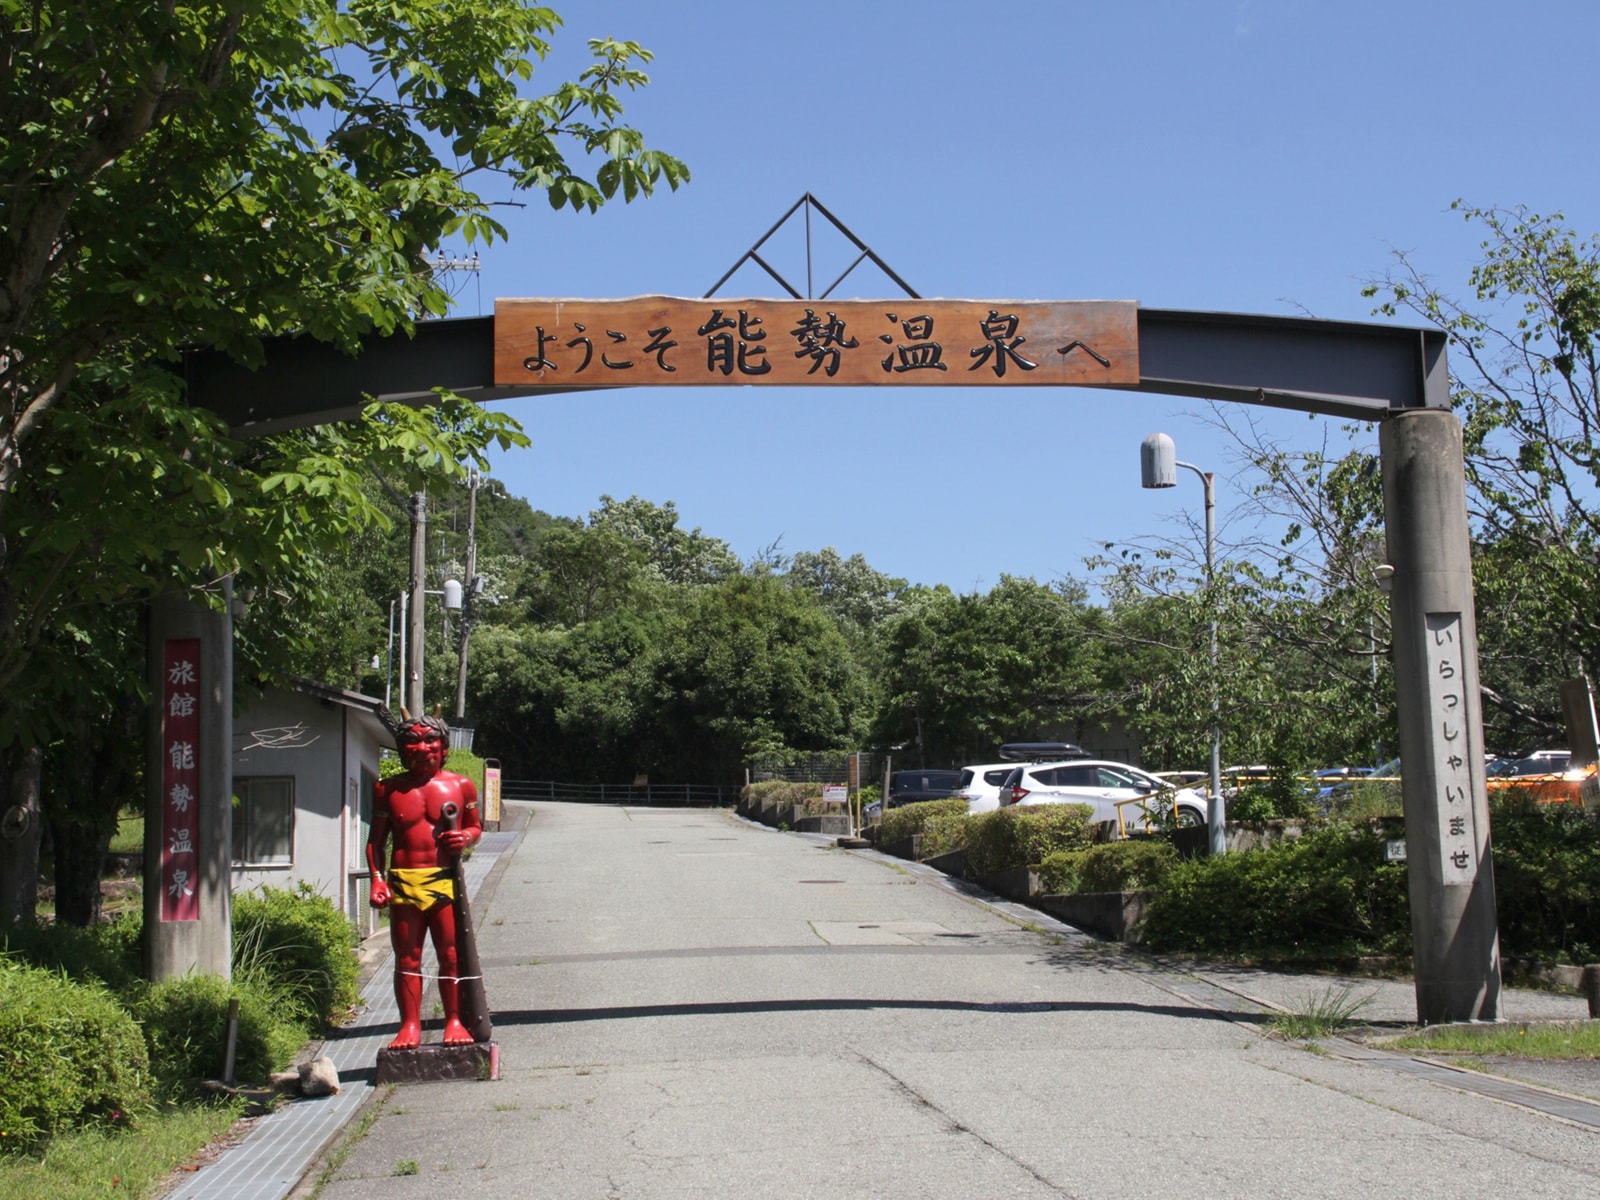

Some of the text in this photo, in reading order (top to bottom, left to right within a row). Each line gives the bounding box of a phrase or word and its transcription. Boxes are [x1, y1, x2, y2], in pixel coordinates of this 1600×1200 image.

[522, 309, 1111, 377] ようこそ能勢温泉へ
[168, 660, 198, 898] 旅館能勢温泉
[1434, 630, 1470, 870] いらっしゃいませ
